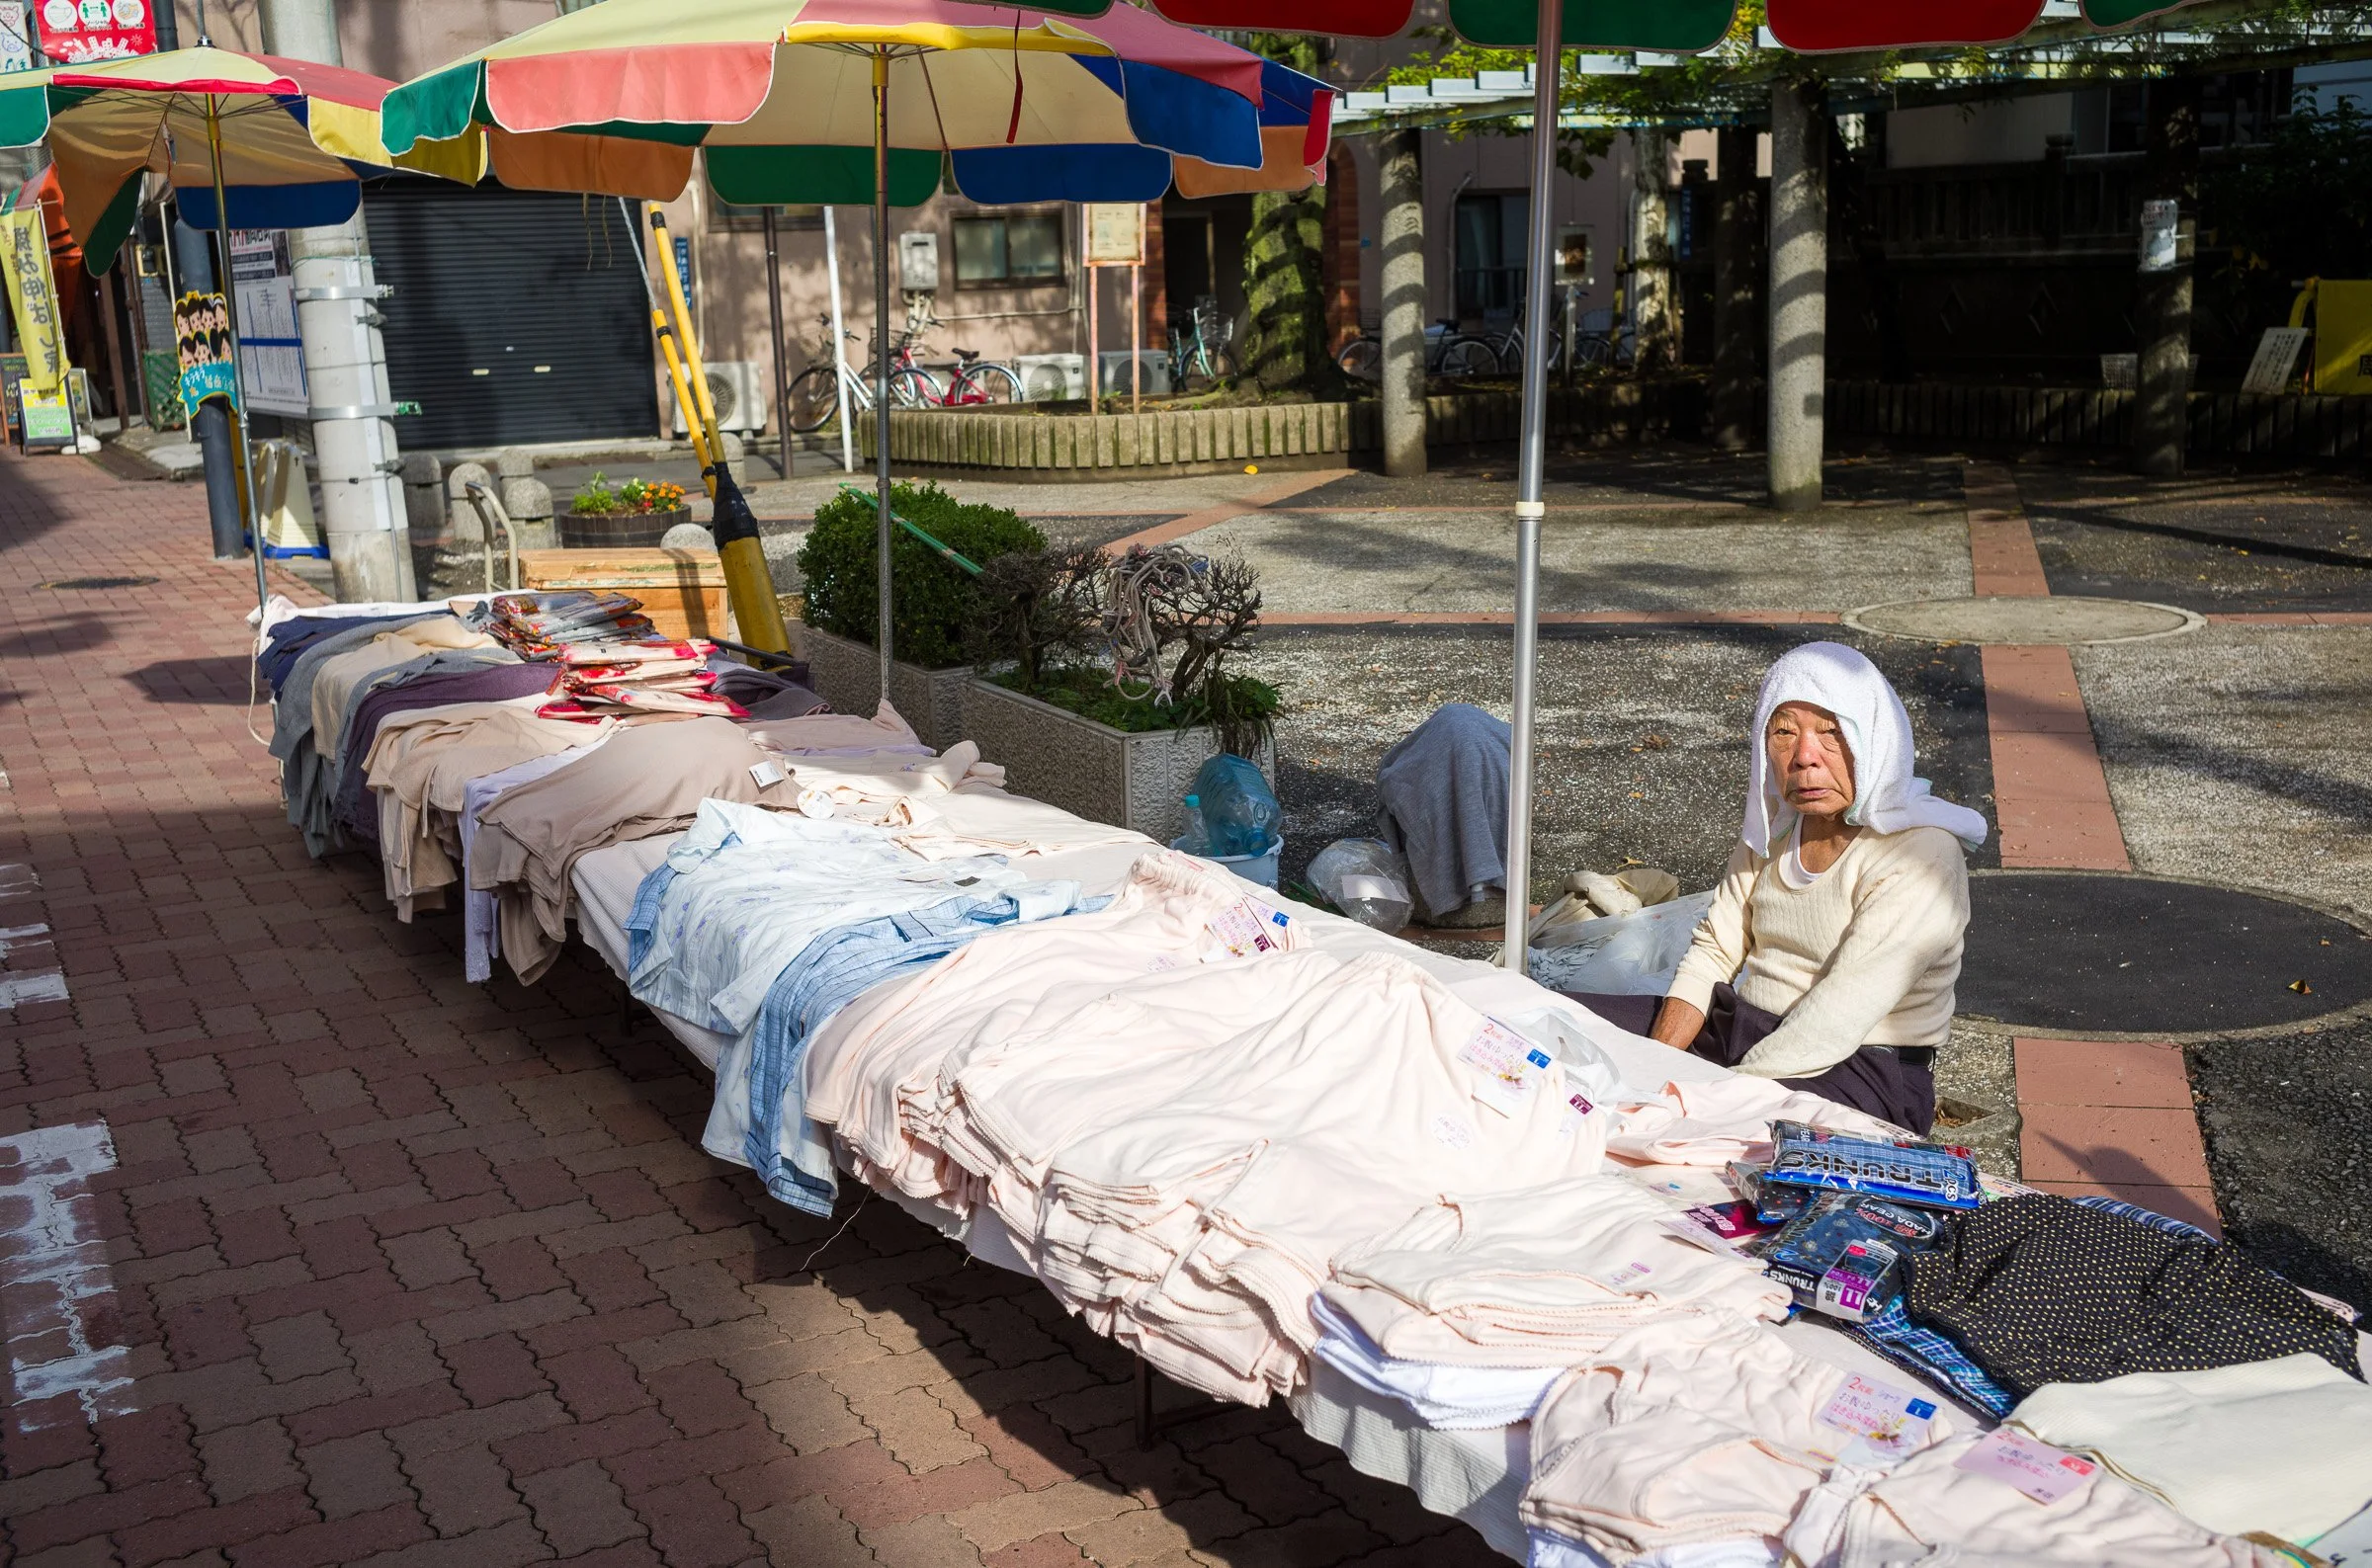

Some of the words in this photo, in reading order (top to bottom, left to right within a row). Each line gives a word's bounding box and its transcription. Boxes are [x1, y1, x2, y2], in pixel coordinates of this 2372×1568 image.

[1779, 1149, 1944, 1190] TRUNKS
[1769, 1270, 1816, 1292] TRUNKS
[1845, 1287, 1863, 1306] LL
